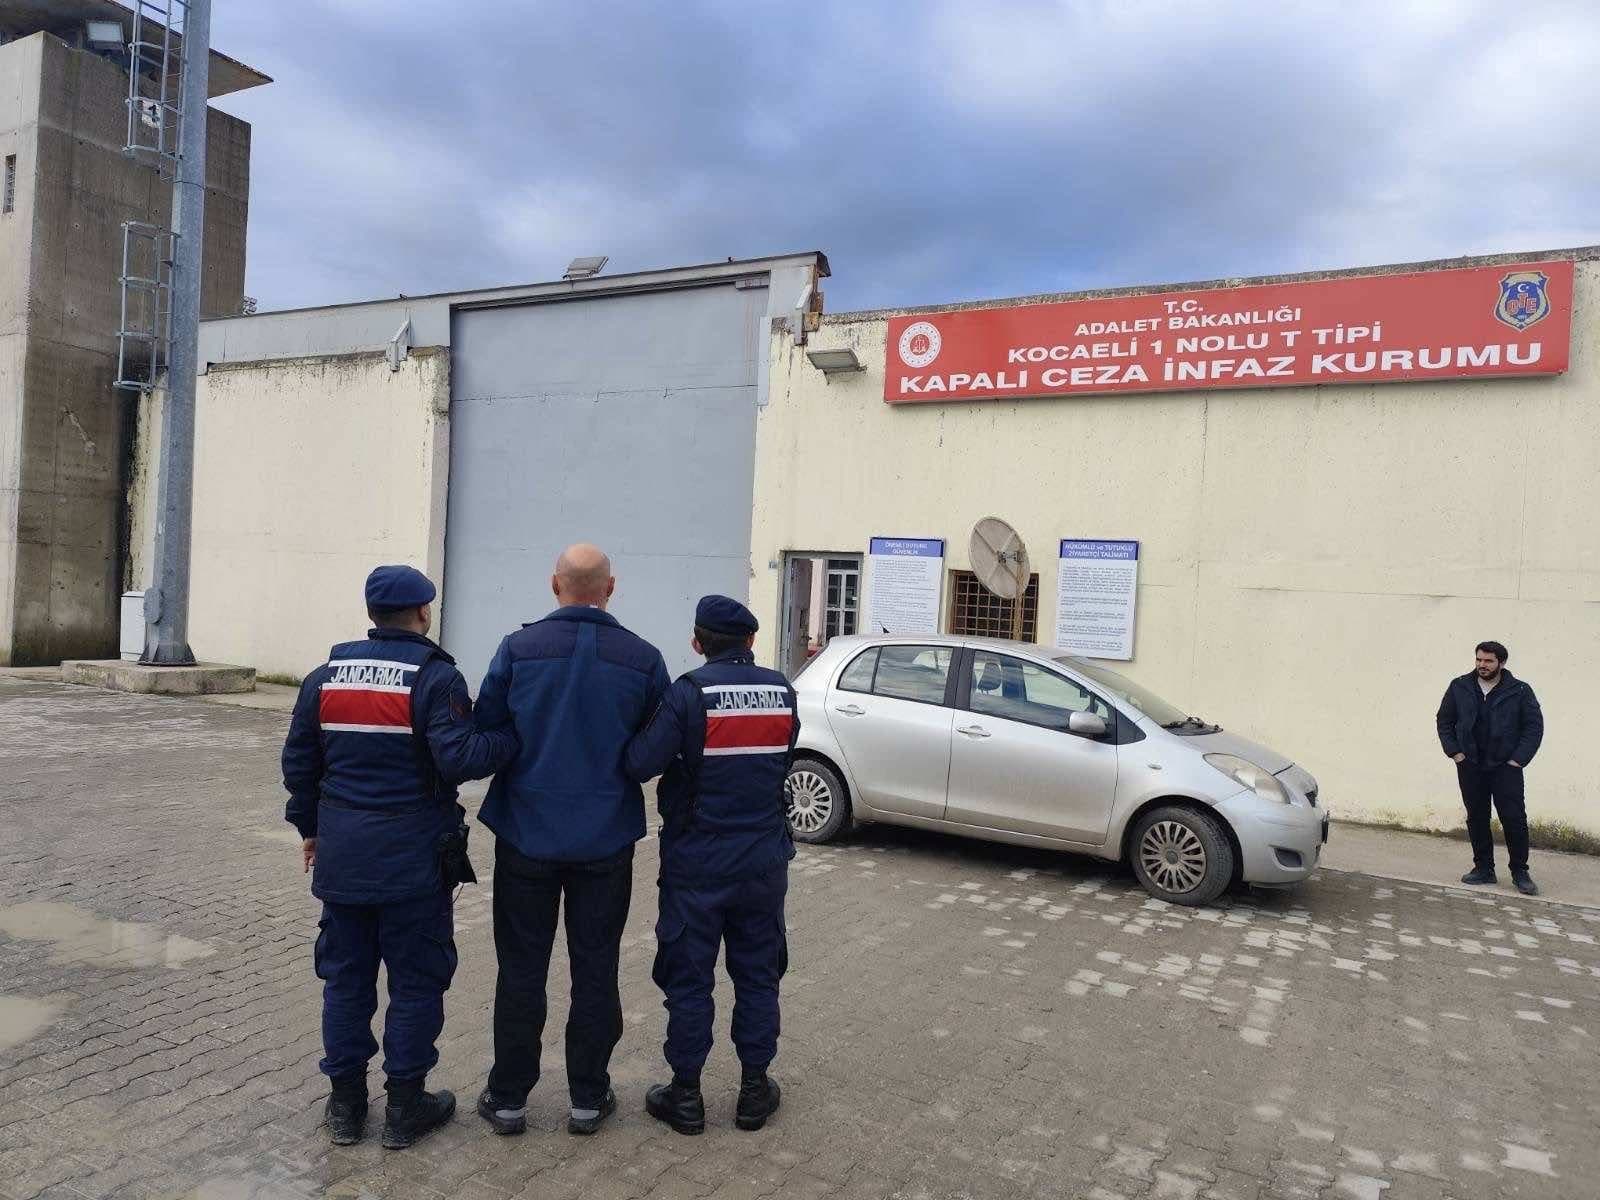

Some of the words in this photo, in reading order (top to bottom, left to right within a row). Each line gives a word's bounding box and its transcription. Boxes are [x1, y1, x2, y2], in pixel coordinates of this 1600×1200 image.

[1163, 300, 1204, 314] T.C.
[1074, 318, 1162, 336] ADALET
[1168, 305, 1302, 330] BAKANLIĞI
[1008, 337, 1138, 363] KOCAELİ
[1149, 342, 1162, 355] 1
[1176, 331, 1269, 353] NOLU
[1280, 330, 1302, 347] T
[1312, 321, 1382, 345] TİPİ
[900, 371, 1028, 394] KAPALI
[1041, 364, 1150, 388] CEZA
[1163, 355, 1296, 381] İNFAZ
[1311, 342, 1542, 374] KURUMU
[330, 665, 404, 686] JANDARMA
[715, 690, 786, 709] JANDARMA
